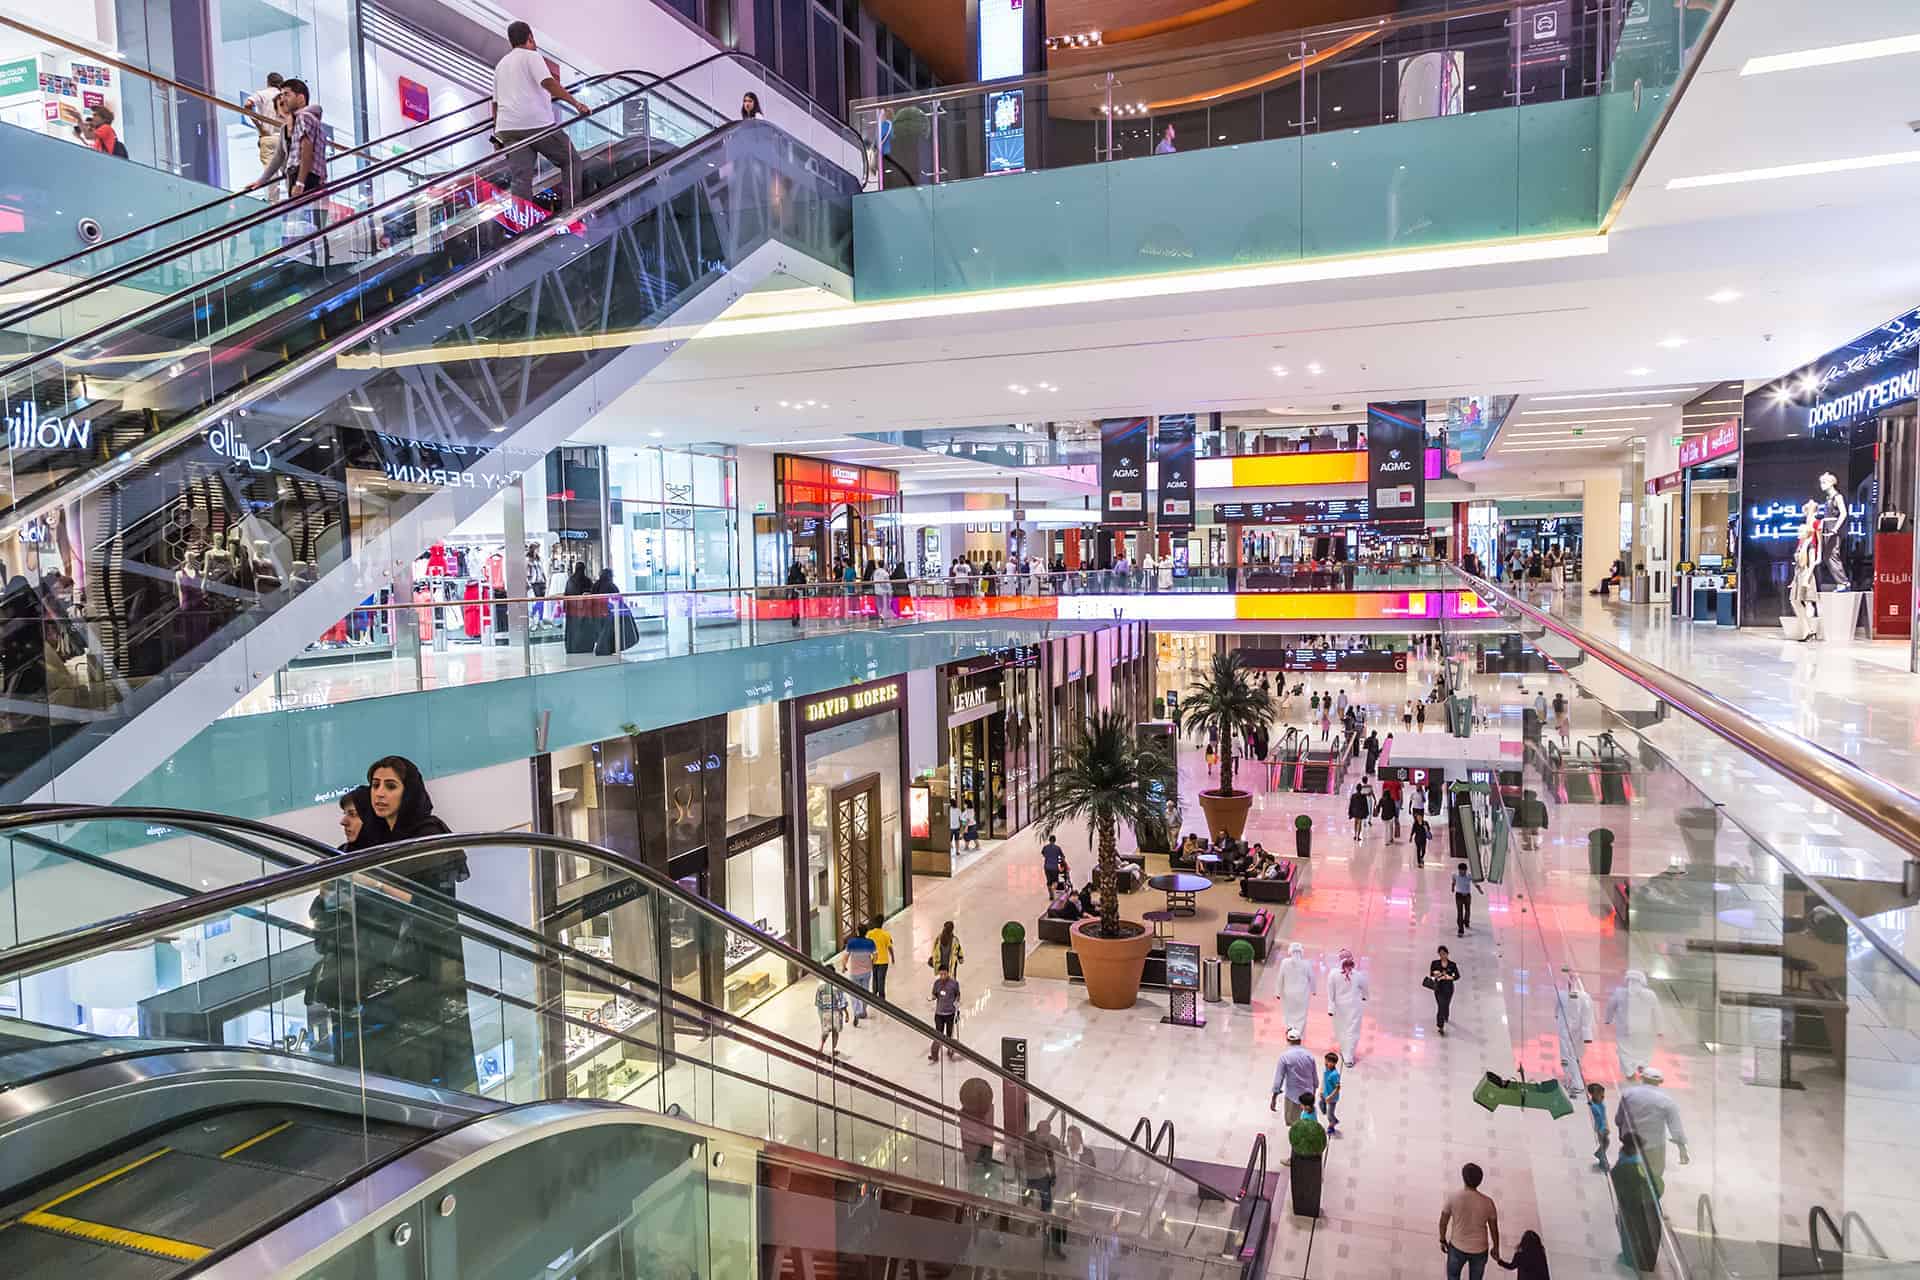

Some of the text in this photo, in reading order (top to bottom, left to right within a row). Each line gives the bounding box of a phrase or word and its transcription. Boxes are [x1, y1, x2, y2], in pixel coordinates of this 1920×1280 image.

[1808, 367, 1920, 428] DOROTHY PERKI
[1379, 461, 1411, 472] AGMC
[1112, 468, 1139, 478] AGMC
[1166, 480, 1188, 489] AGMC
[1394, 658, 1404, 670] G
[808, 684, 898, 721] DAVID MORRIS
[953, 687, 987, 712] LEVANT
[1414, 770, 1425, 783] P
[1016, 1043, 1025, 1053] G
